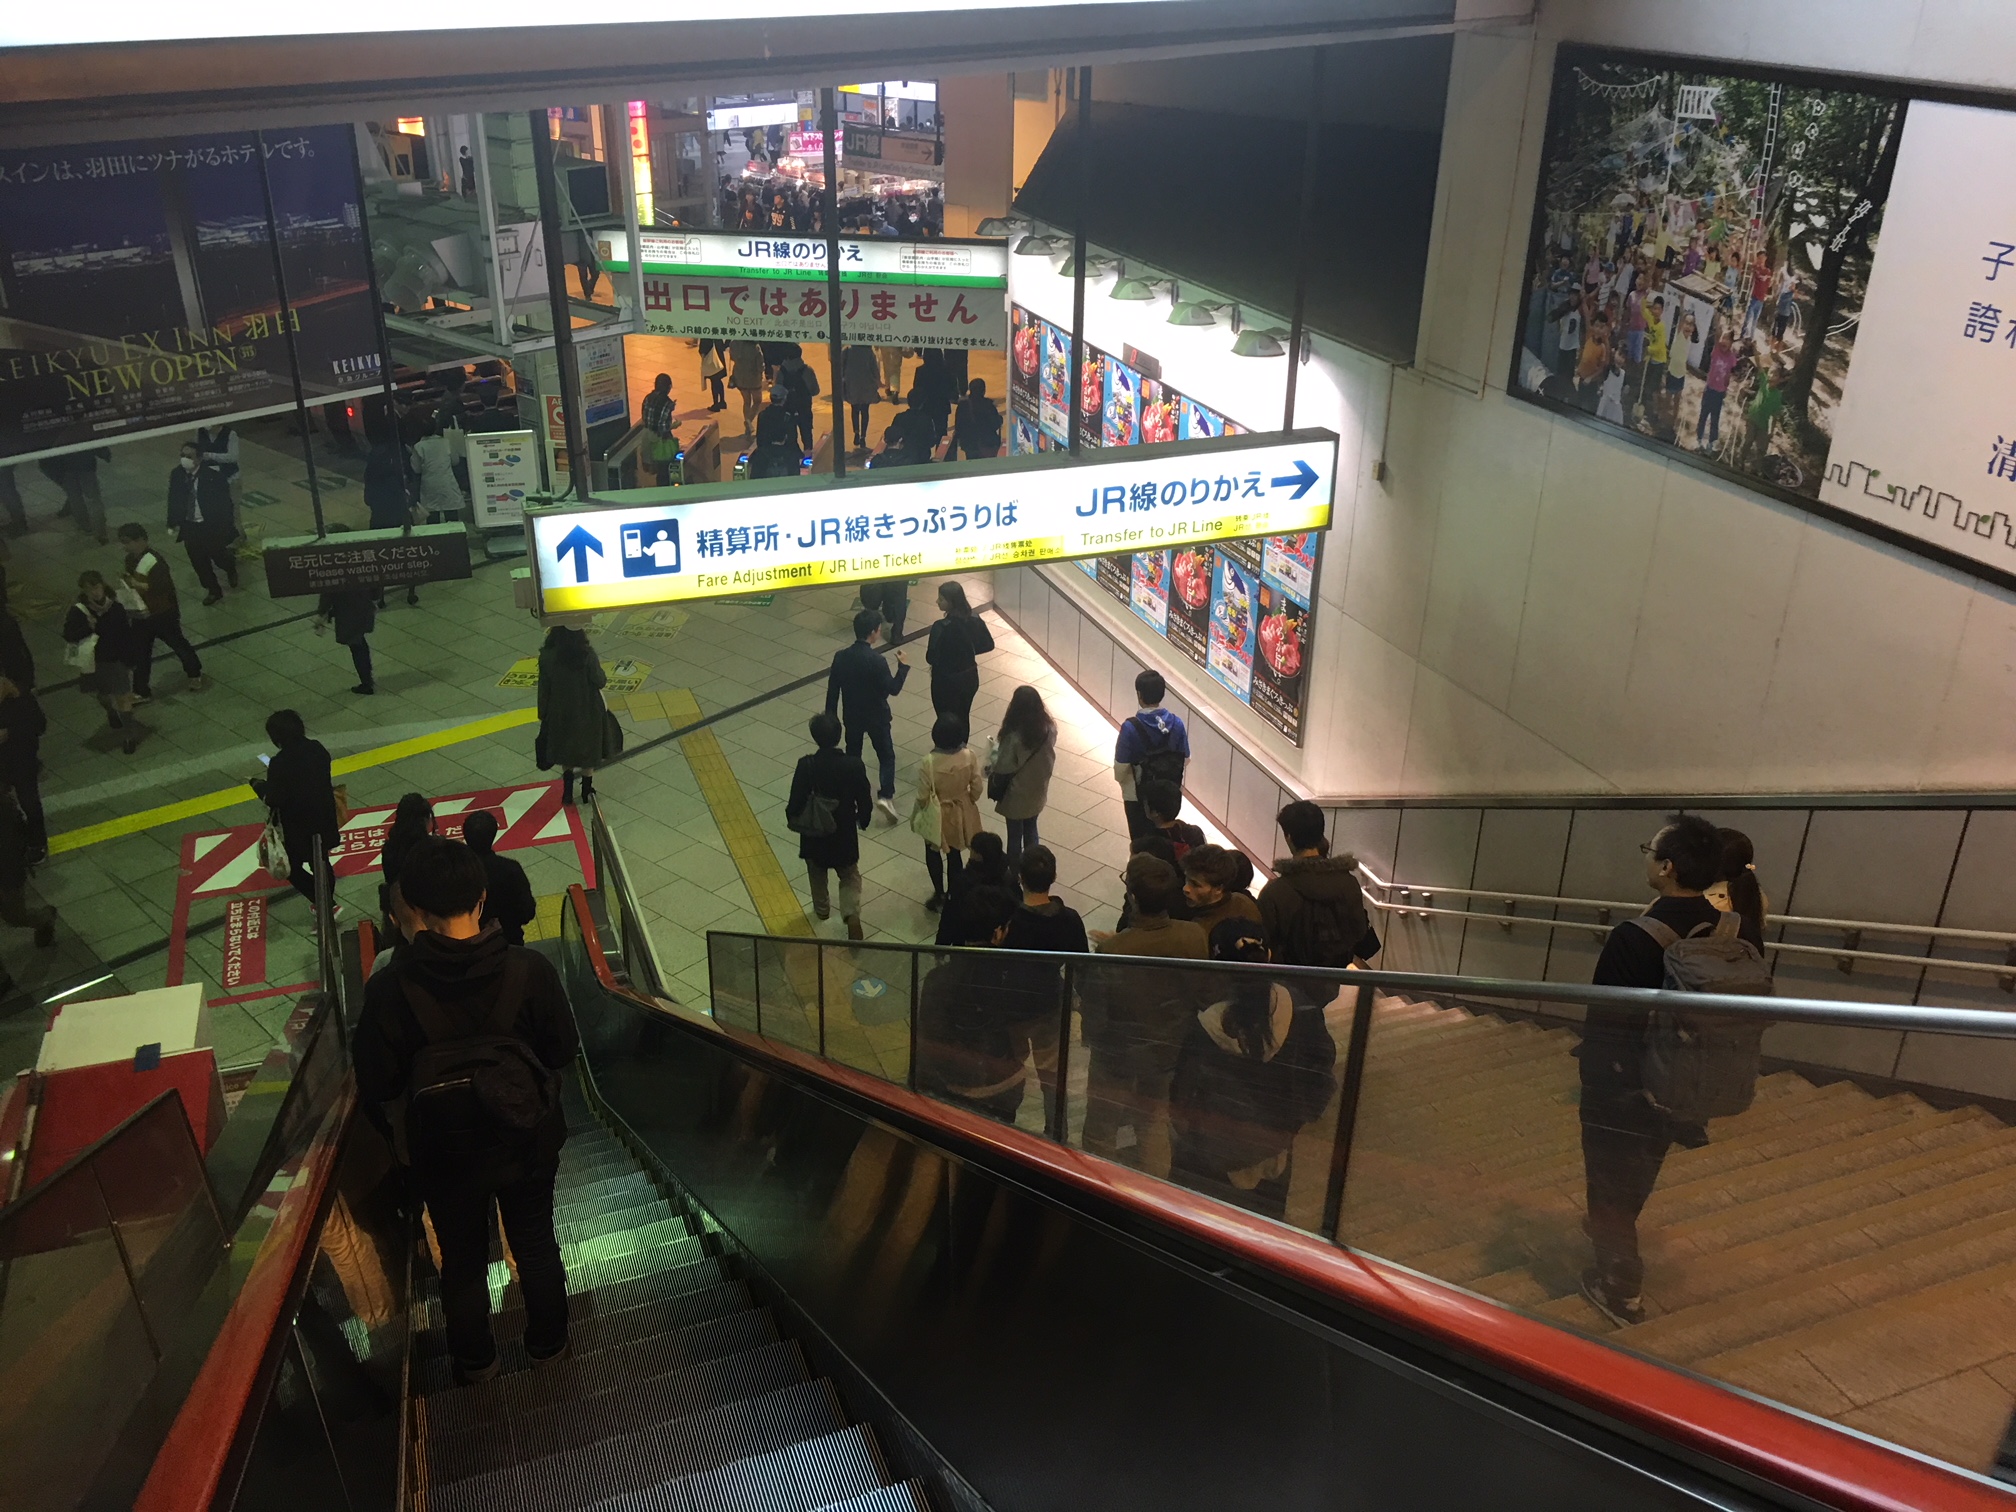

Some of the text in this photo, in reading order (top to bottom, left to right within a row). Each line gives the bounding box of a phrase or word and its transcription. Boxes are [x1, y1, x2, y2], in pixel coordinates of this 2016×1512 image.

[739, 266, 769, 275] Transfer
[796, 269, 812, 277] Line
[1982, 240, 2016, 282] 子
[643, 281, 978, 324] 出口ではありません
[727, 317, 741, 325] NO
[743, 318, 764, 326] EXIT
[0, 344, 110, 381] EIKYU
[120, 326, 162, 363] EX
[332, 353, 381, 375] KEIKYU
[63, 361, 143, 401] NEW
[149, 345, 238, 386] OPEN
[1075, 470, 1266, 518] JR線のりかえ
[1081, 519, 1223, 546] Transfer to JR Line
[288, 544, 441, 570] 足元にご注意ください。
[308, 558, 433, 579] Please watch your step.
[697, 551, 922, 589] Fare Adjustment / JR Line Ticket
[1252, 675, 1294, 713] みさきまぐろきっぷ
